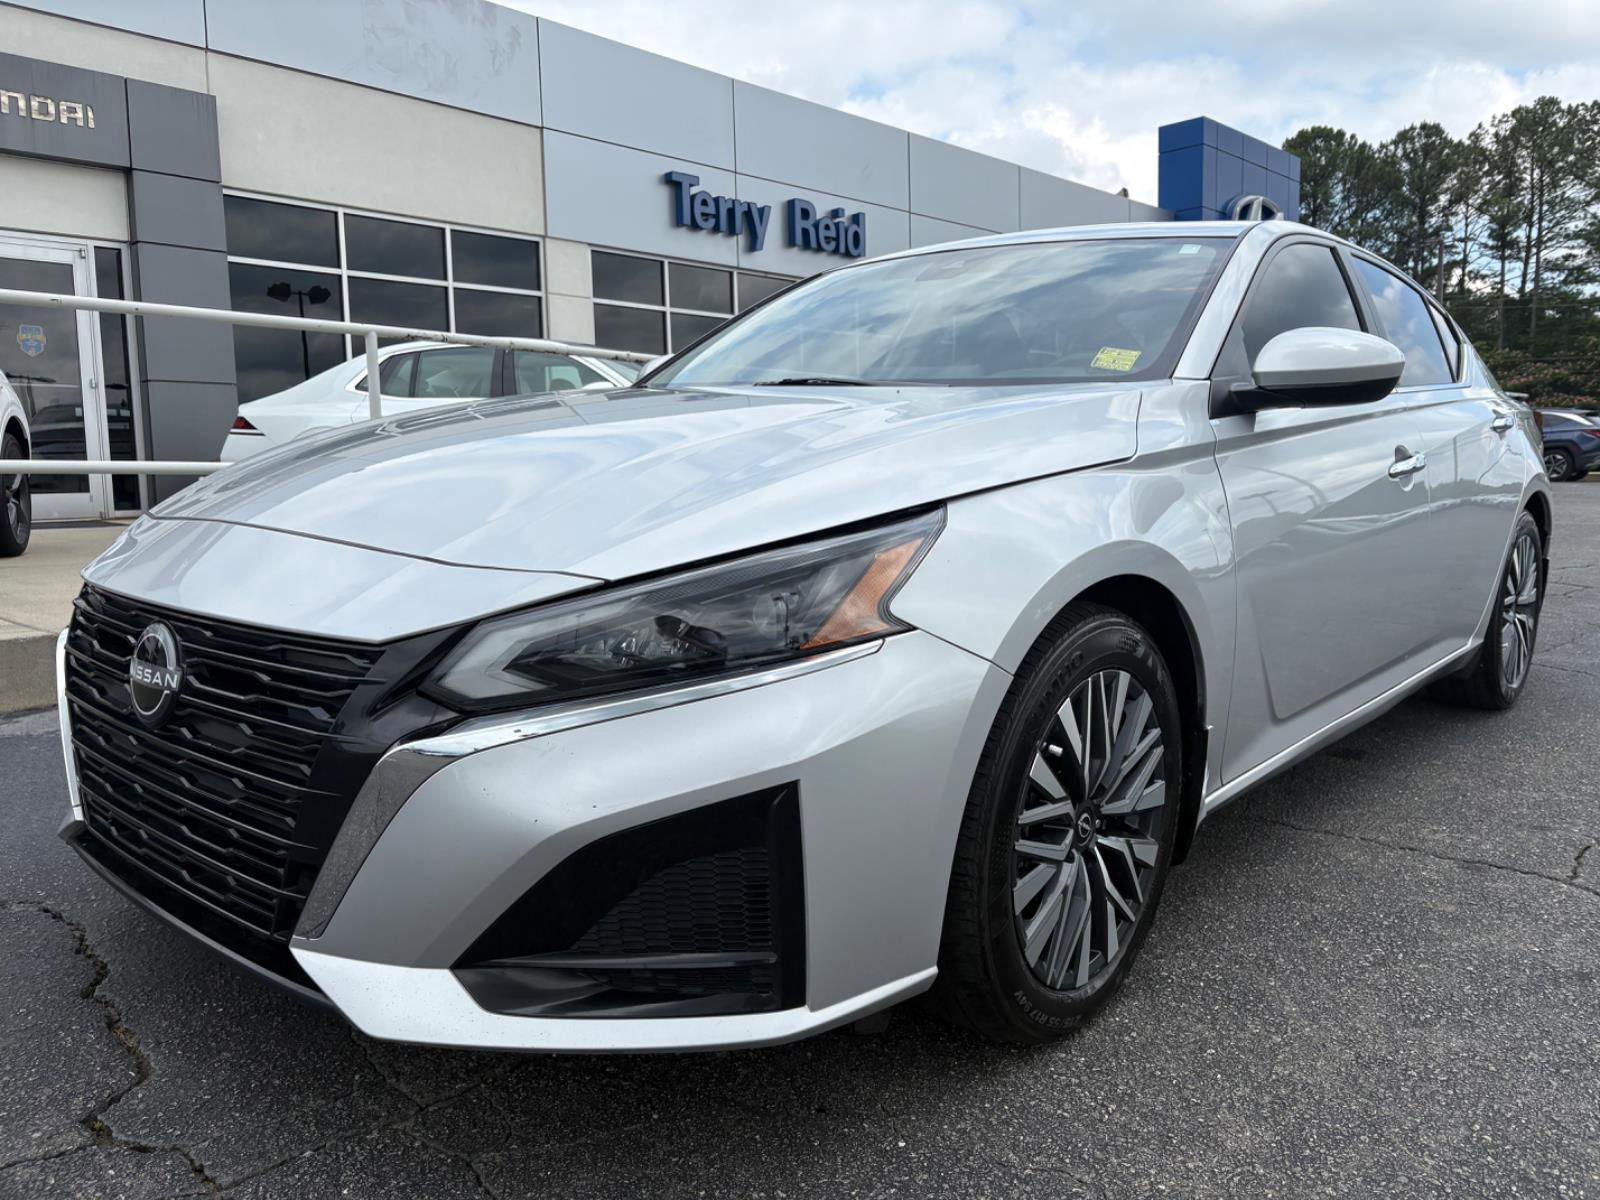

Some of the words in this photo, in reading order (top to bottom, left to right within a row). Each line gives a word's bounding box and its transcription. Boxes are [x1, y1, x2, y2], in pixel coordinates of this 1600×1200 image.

[665, 171, 771, 252] Terry
[788, 198, 865, 257] Reid
[132, 665, 178, 688] SSAN
